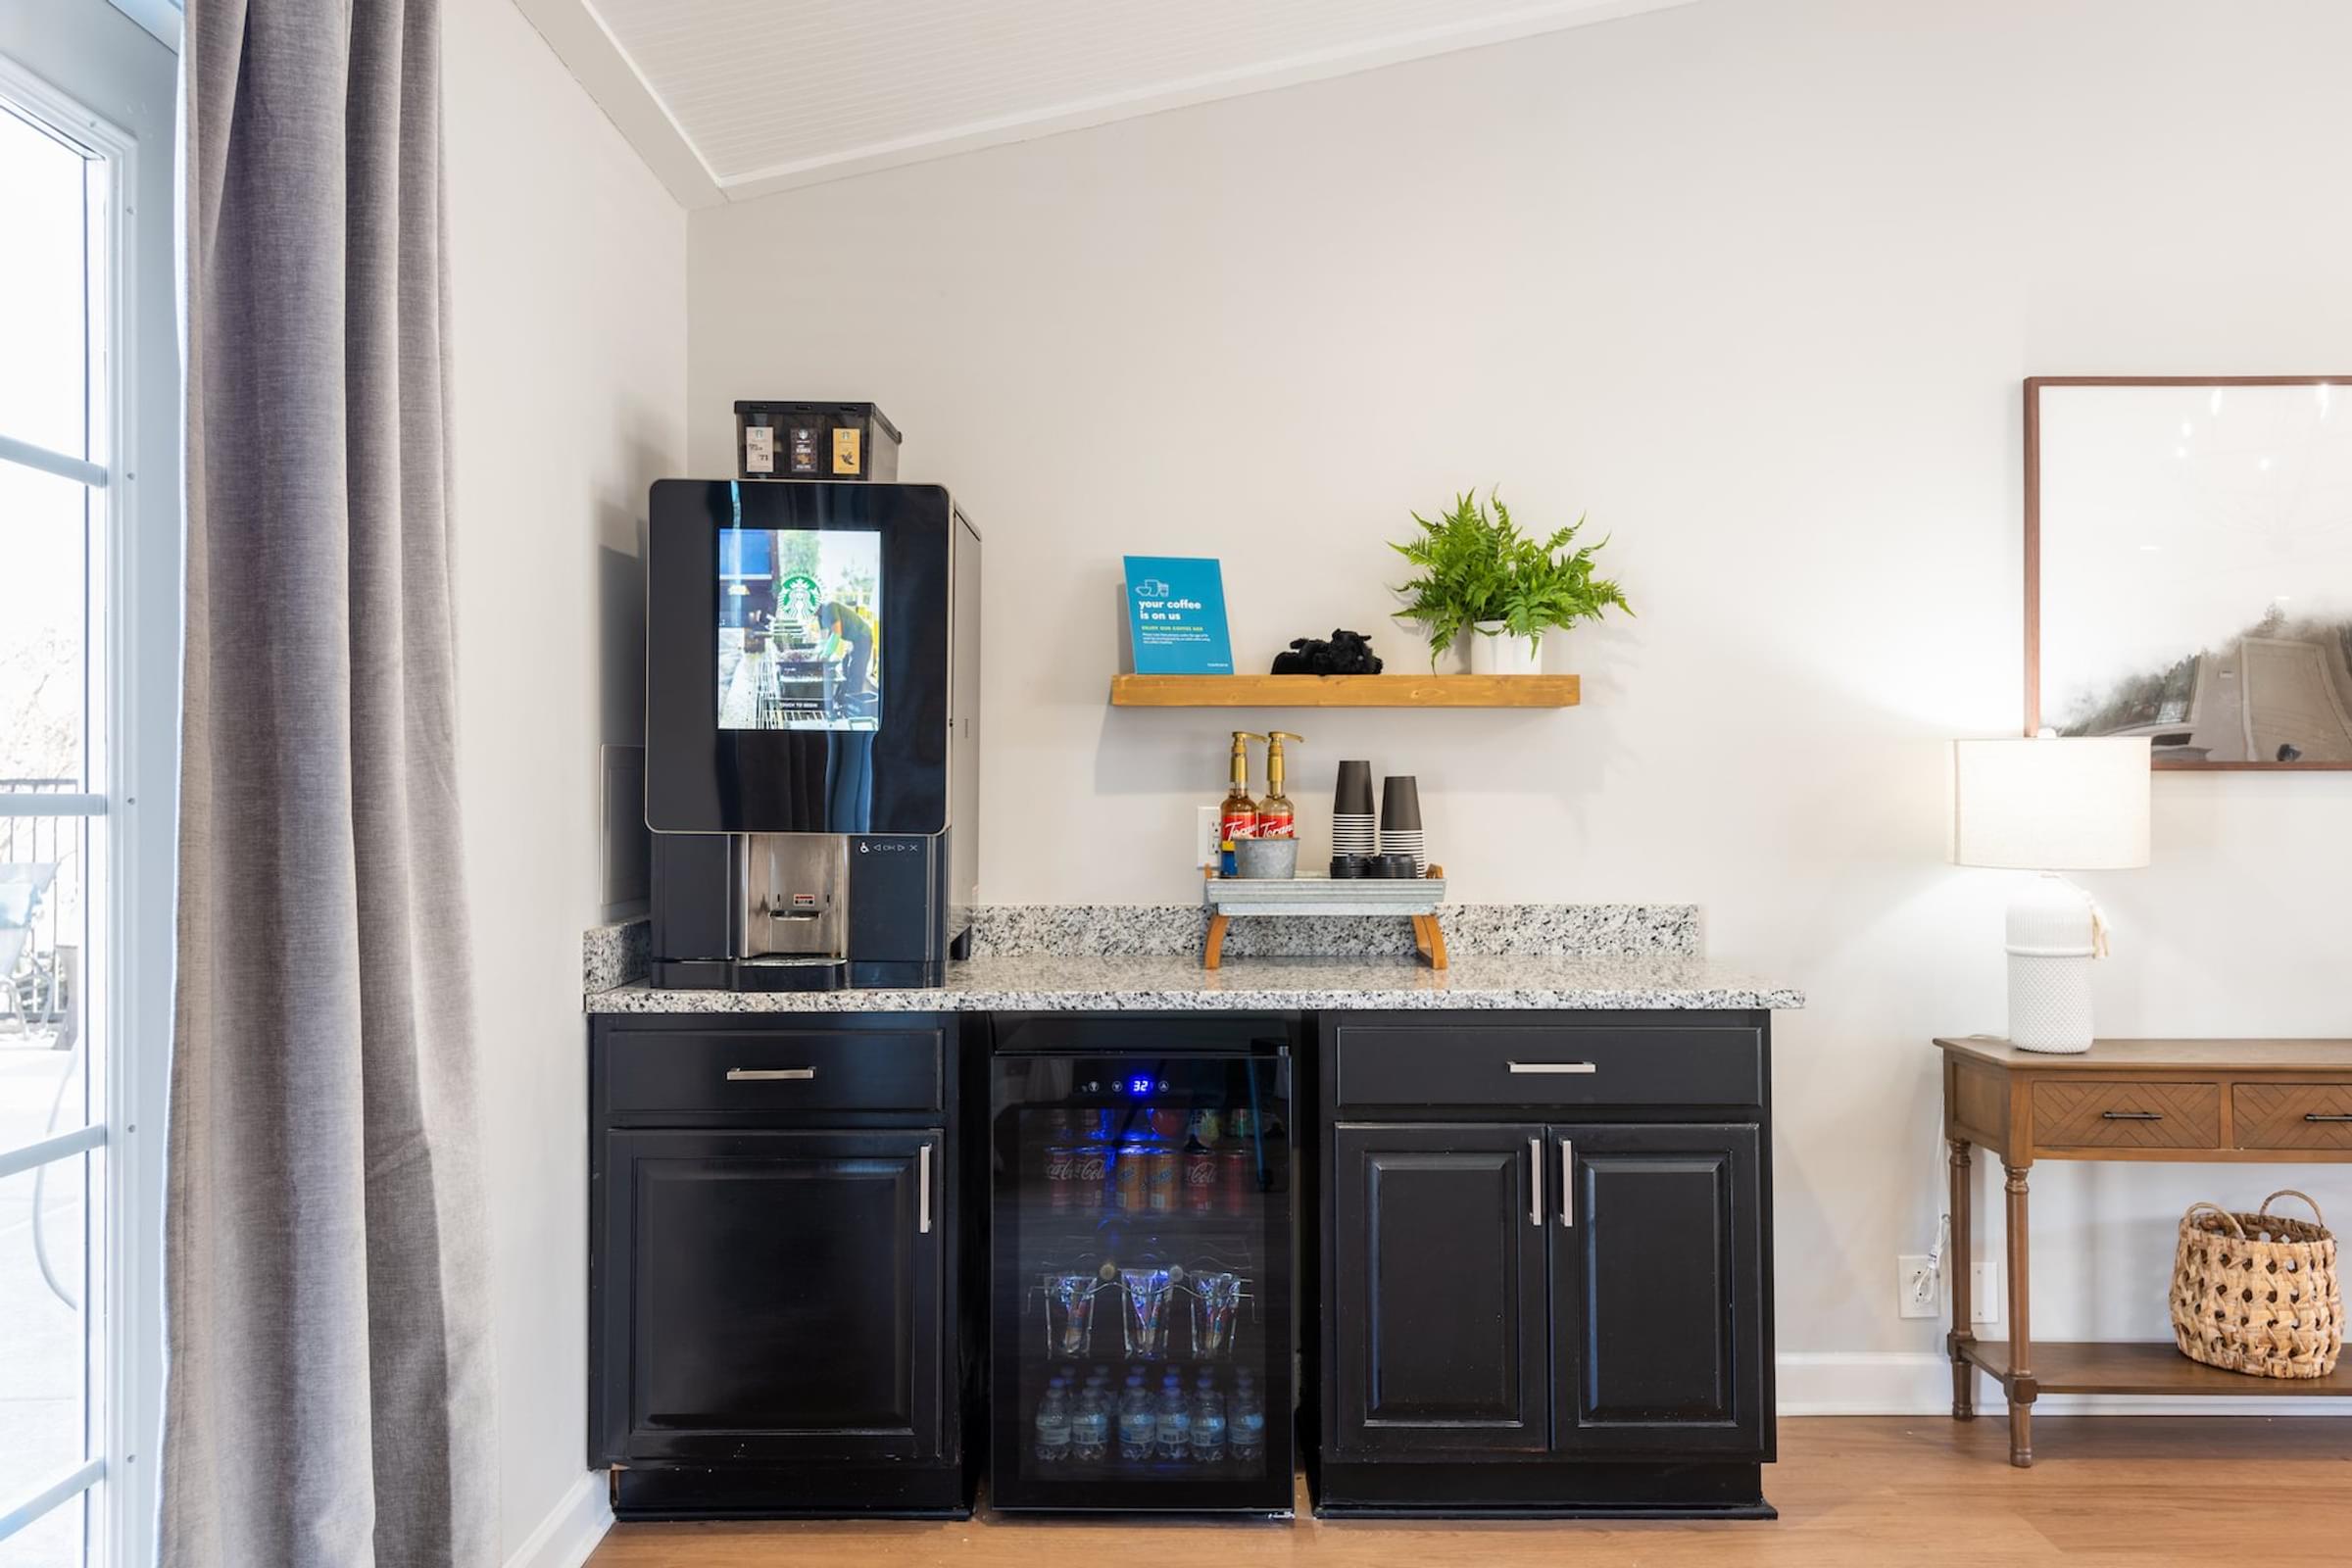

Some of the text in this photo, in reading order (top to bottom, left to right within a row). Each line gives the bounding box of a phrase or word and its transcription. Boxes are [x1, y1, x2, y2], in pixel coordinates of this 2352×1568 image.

[1139, 599, 1201, 611] your coffee
[1140, 611, 1150, 620] is
[1133, 1080, 1149, 1092] 32
